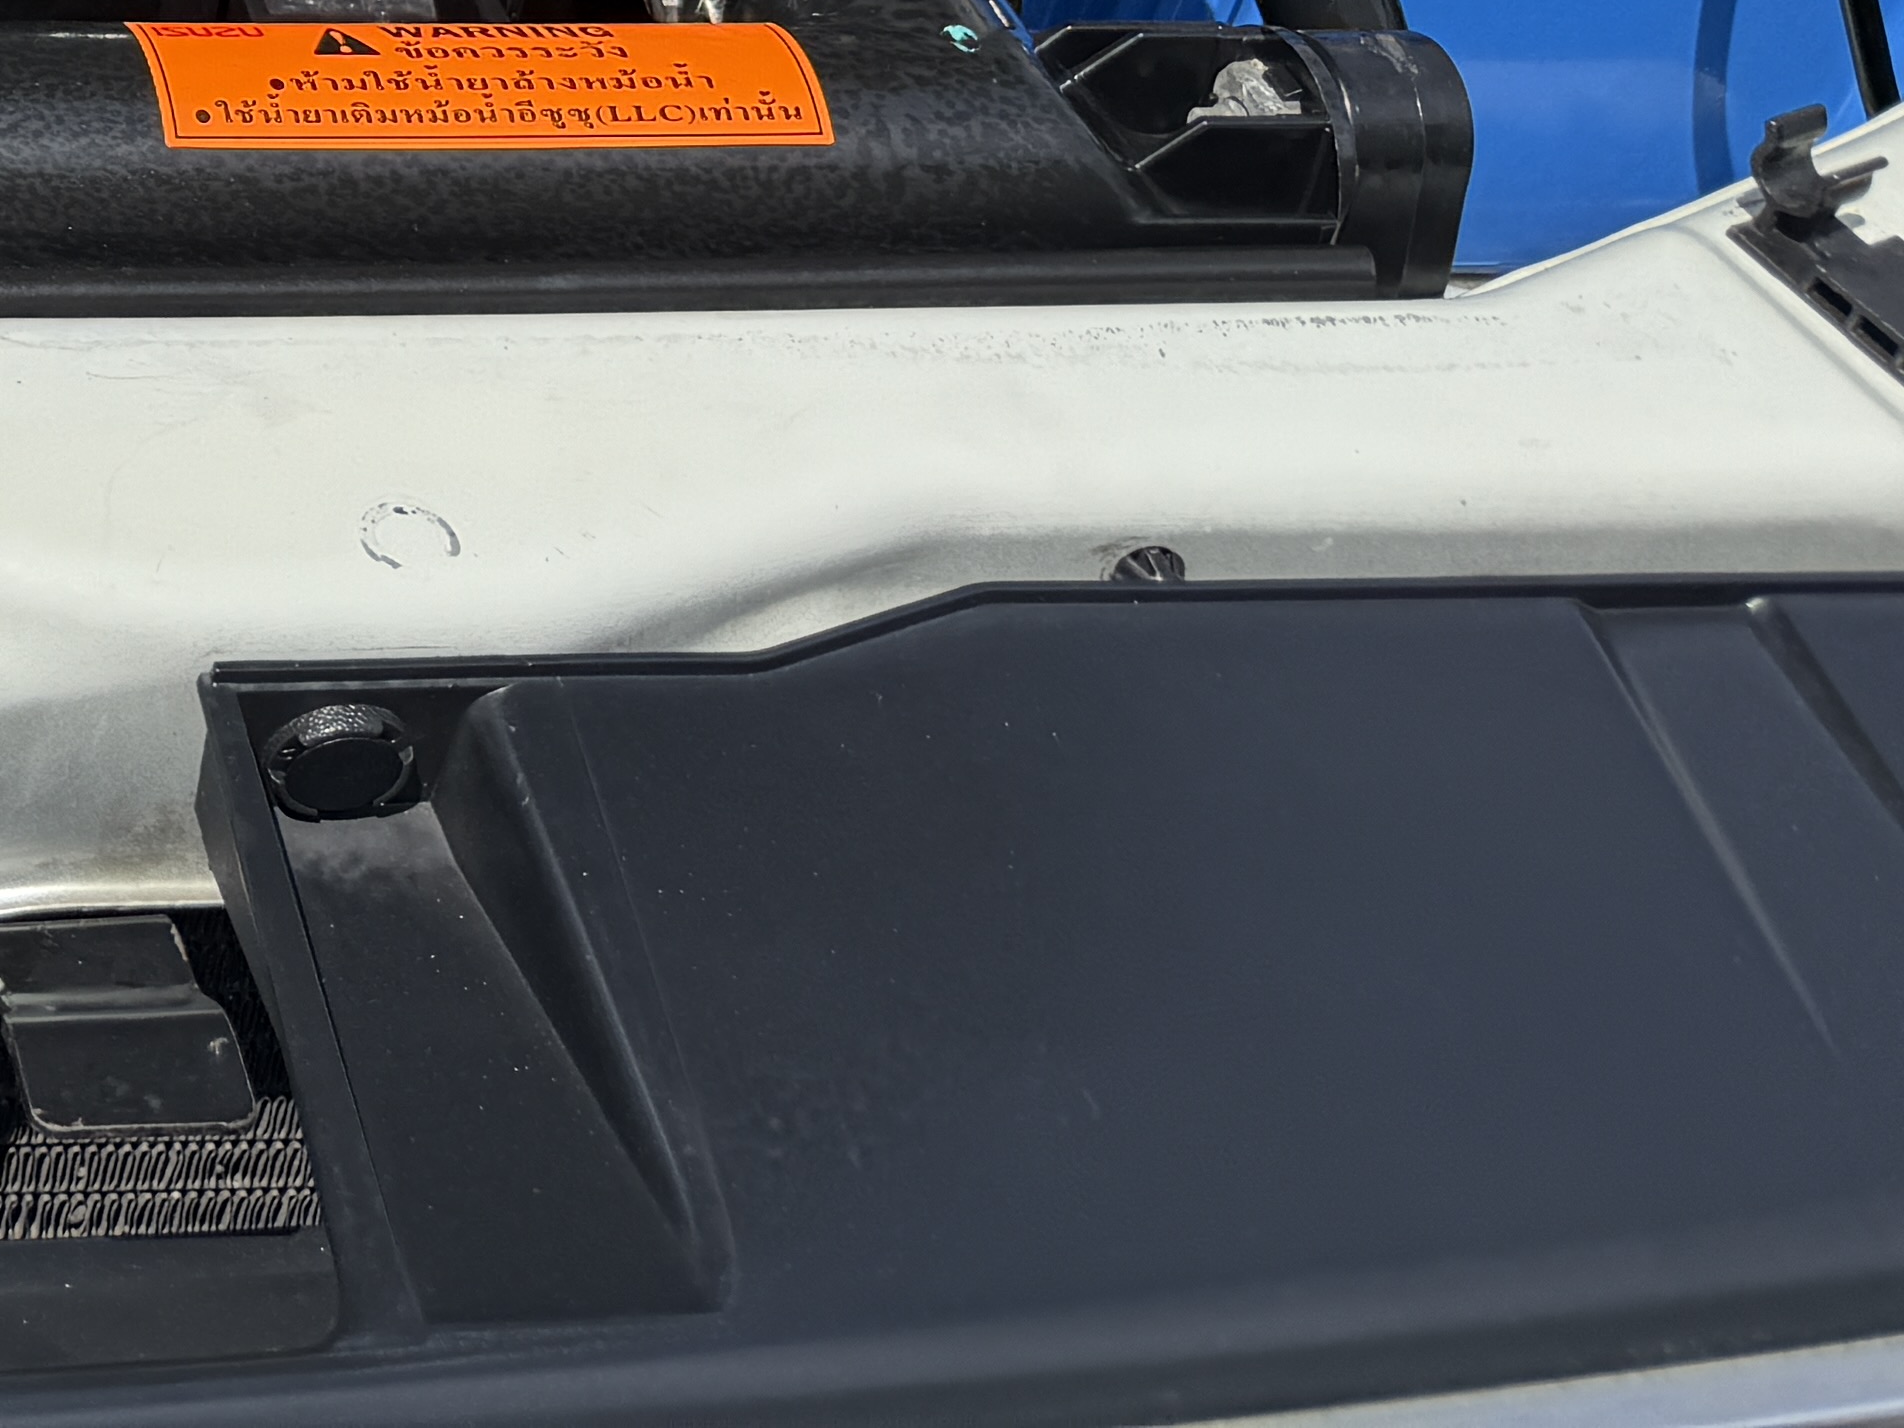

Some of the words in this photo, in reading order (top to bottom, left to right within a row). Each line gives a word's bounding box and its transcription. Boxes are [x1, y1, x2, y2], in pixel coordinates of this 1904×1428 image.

[150, 25, 265, 40] ISUZU
[381, 25, 616, 41] WARNING
[395, 40, 629, 62] ข้อควรระวัง
[290, 62, 715, 94] ห้ามใช้น้ำยาล้างหม้อน้ำ
